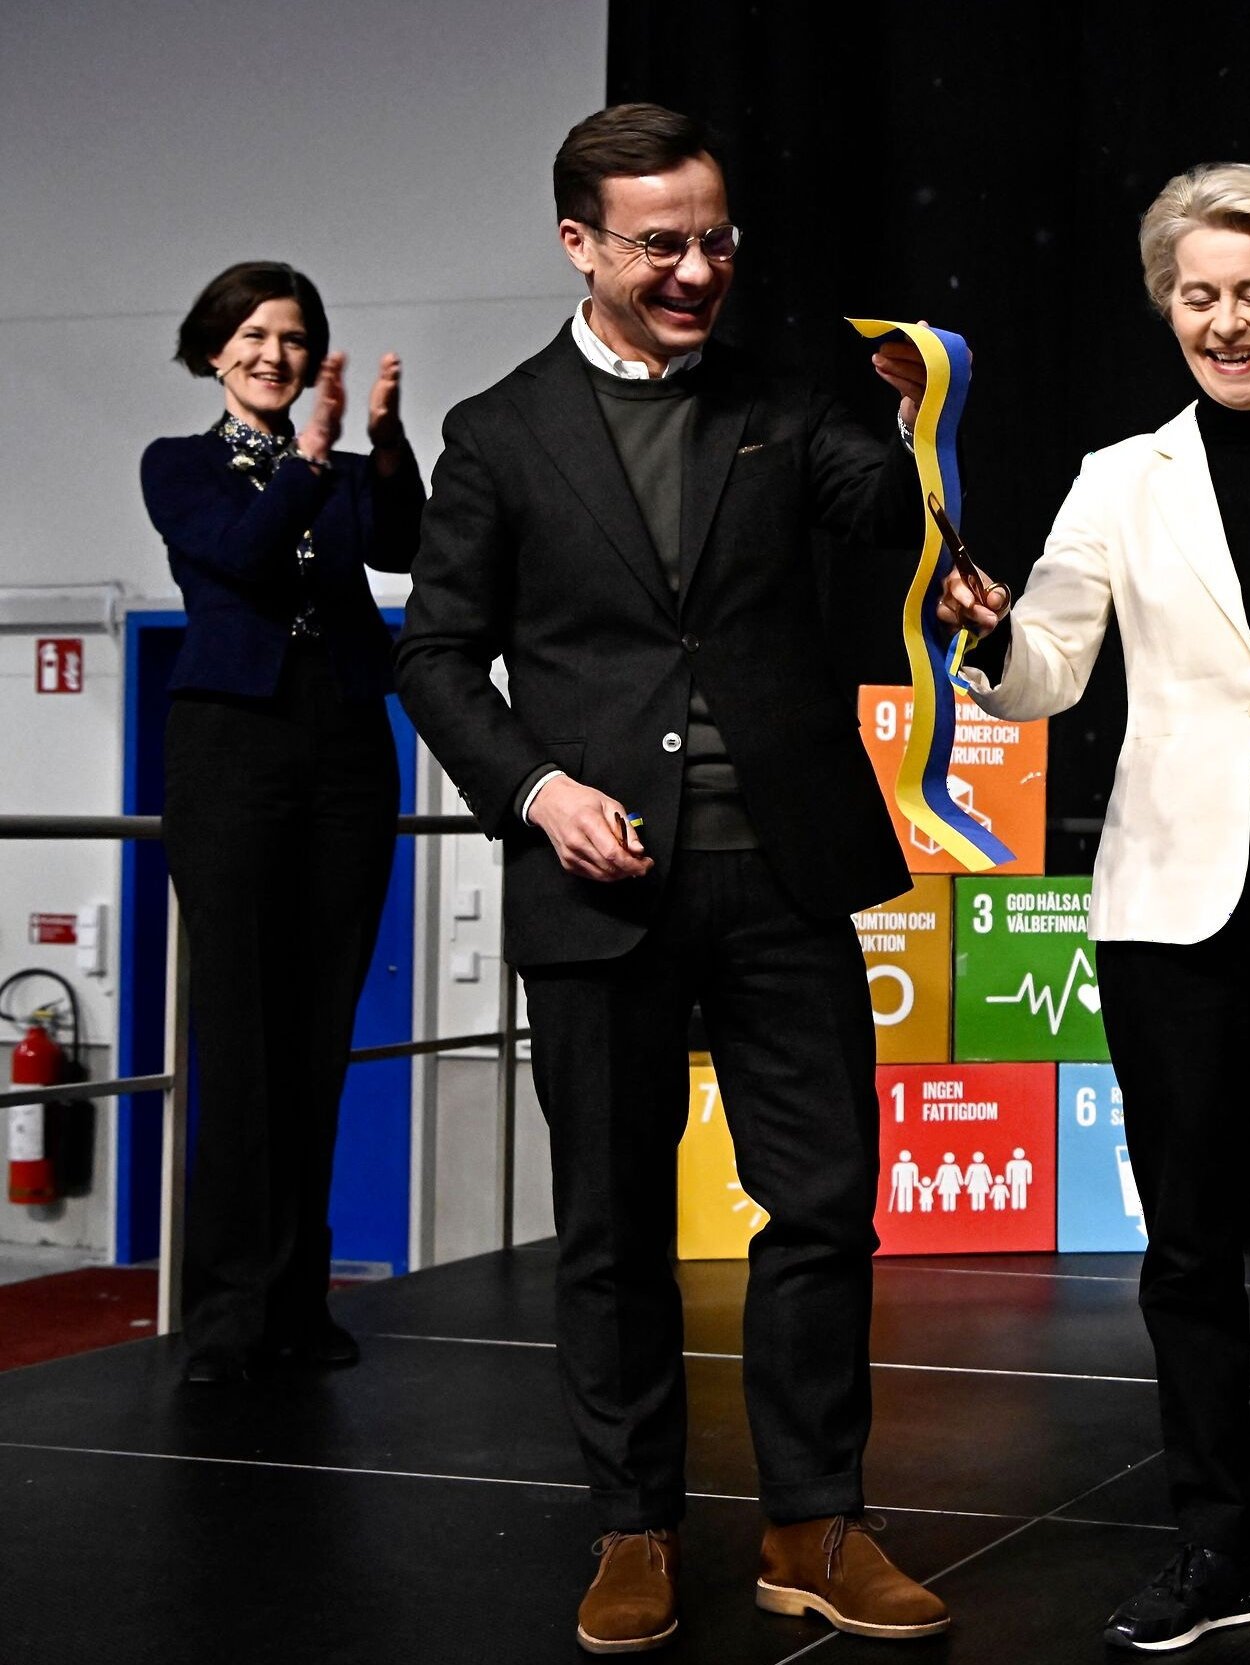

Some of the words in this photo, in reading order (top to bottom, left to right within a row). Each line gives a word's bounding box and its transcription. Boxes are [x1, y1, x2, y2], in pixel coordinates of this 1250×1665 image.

[875, 701, 897, 741] 9
[993, 725, 1020, 744] OCH
[1006, 893, 1035, 912] GOD
[1036, 891, 1081, 912] HÄLSA
[908, 911, 937, 930] OCH
[972, 893, 993, 934] 3
[1006, 912, 1089, 933] VÄLBEFINNA
[922, 1081, 964, 1099] INGEN
[699, 1082, 719, 1123] 7
[891, 1082, 904, 1123] 1
[922, 1102, 998, 1121] FATTIGDOM
[1076, 1086, 1096, 1127] 6
